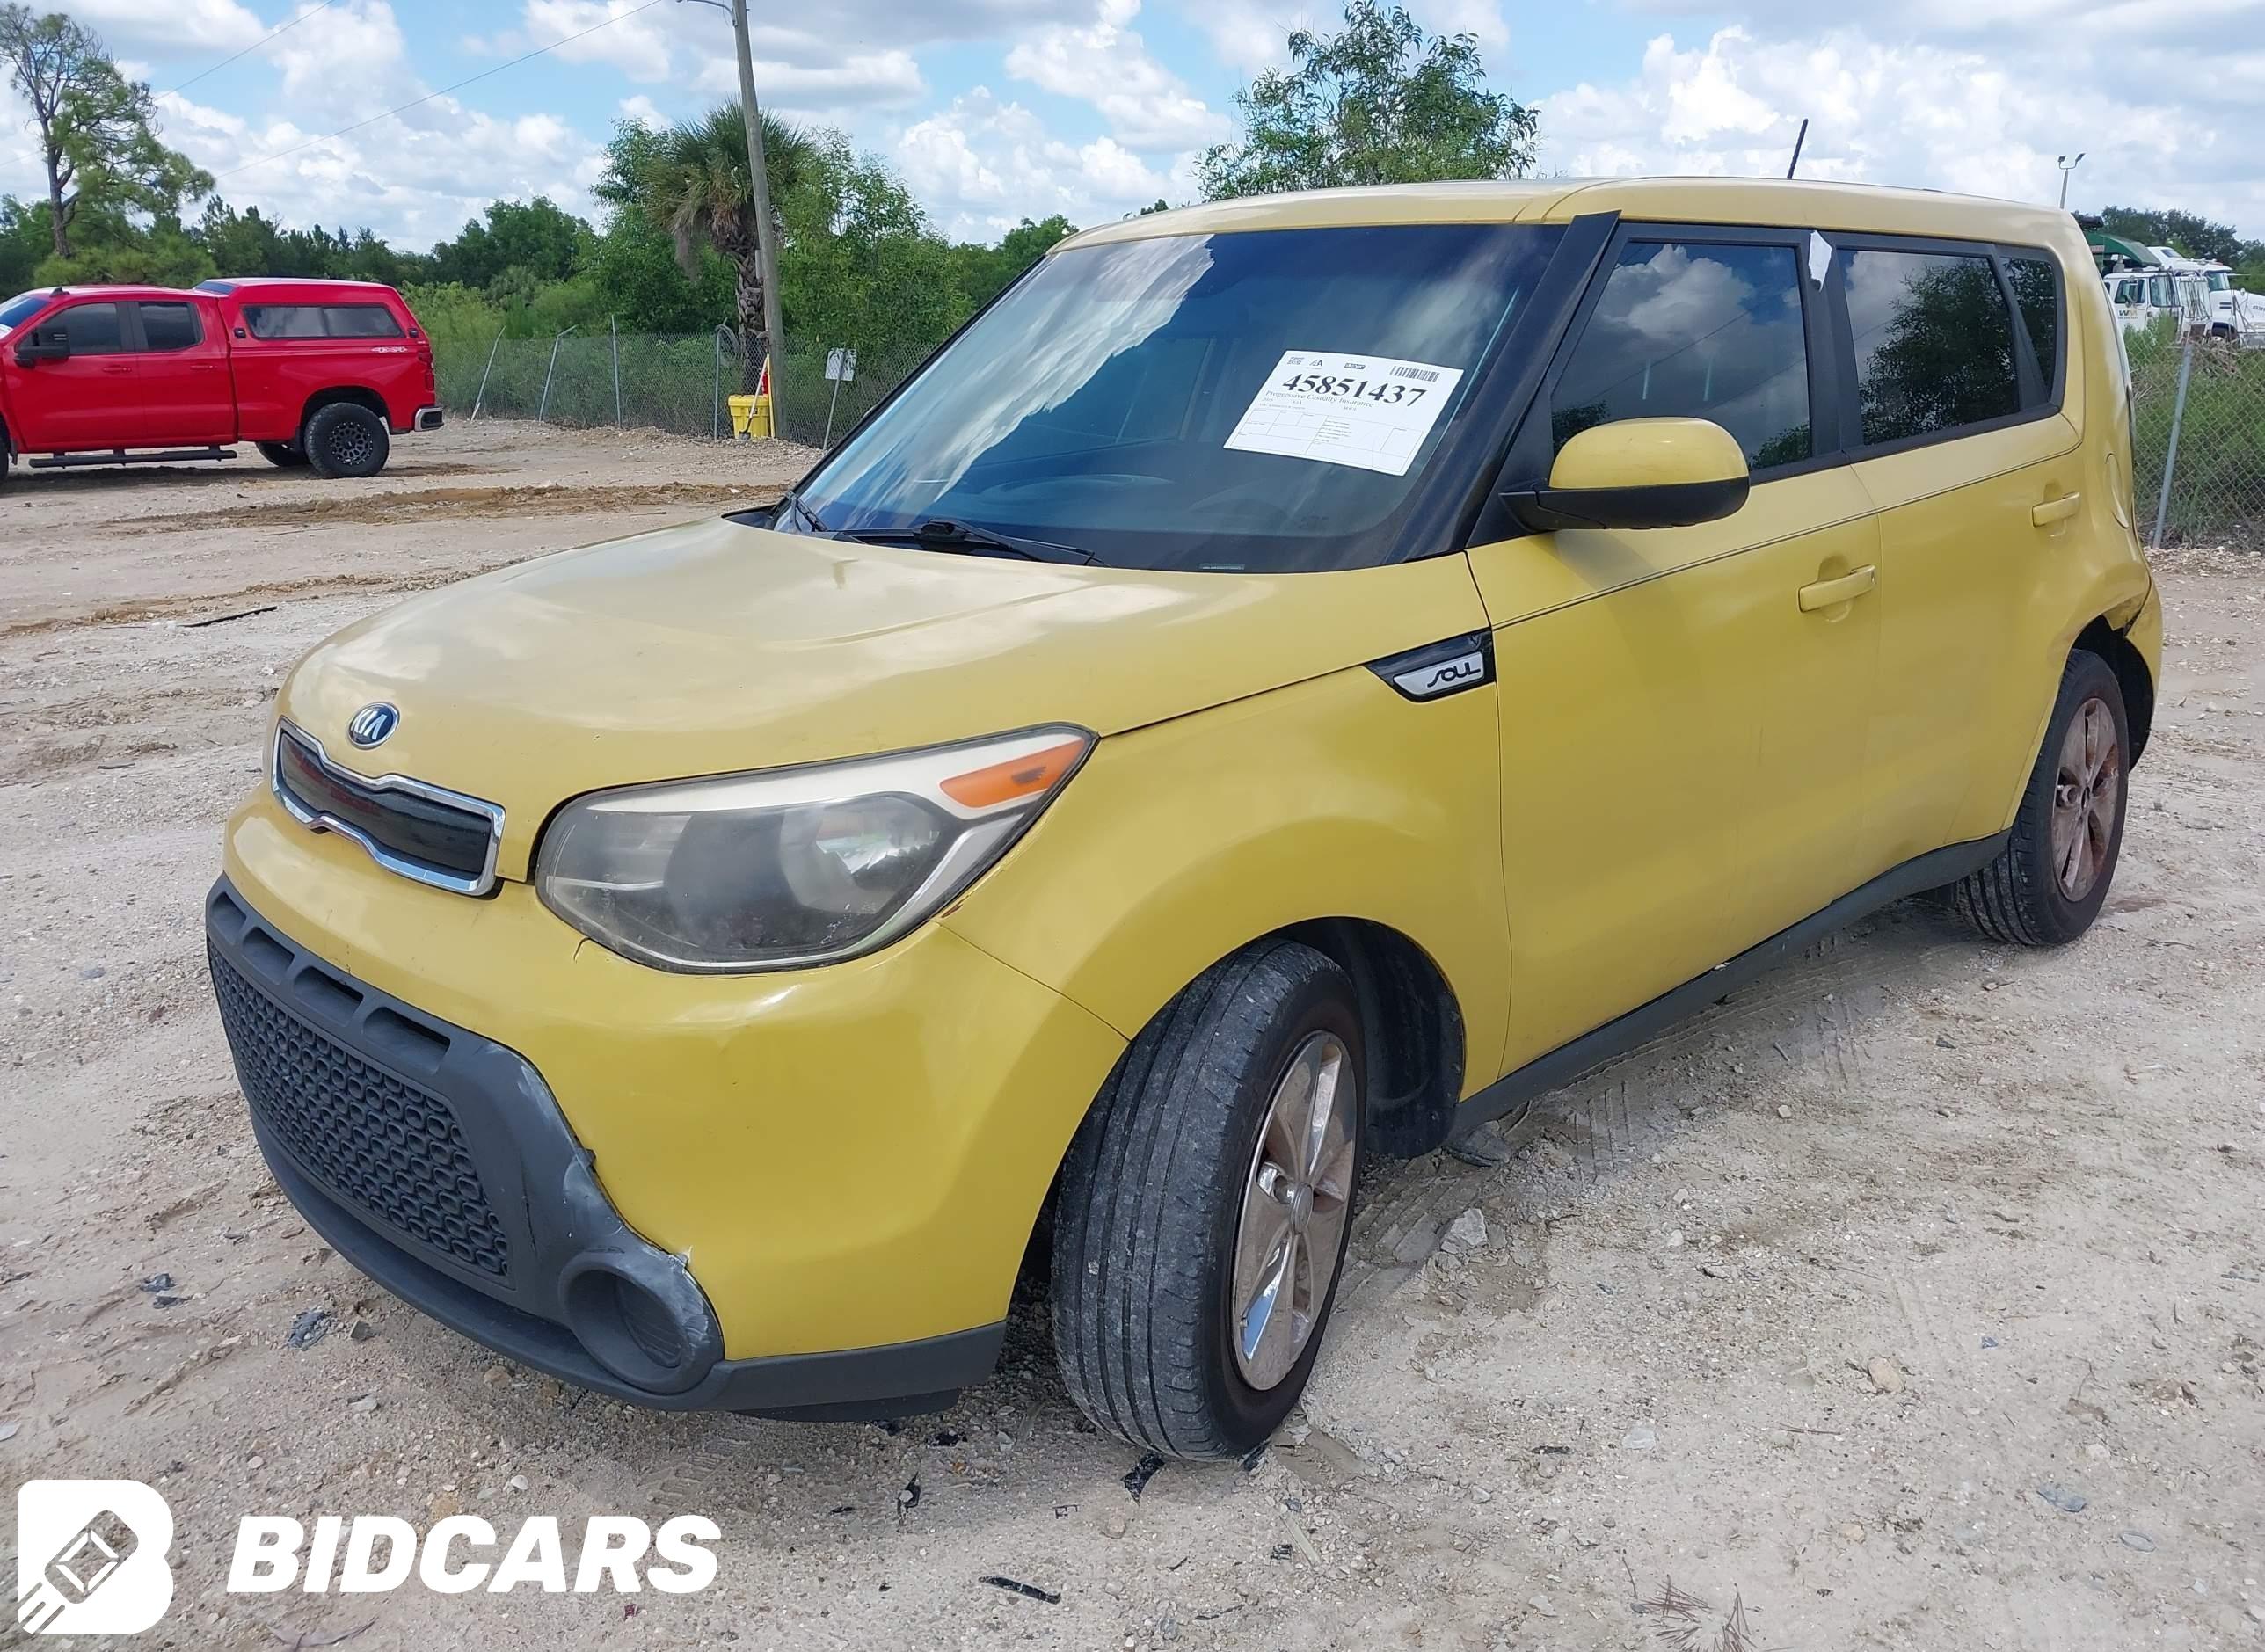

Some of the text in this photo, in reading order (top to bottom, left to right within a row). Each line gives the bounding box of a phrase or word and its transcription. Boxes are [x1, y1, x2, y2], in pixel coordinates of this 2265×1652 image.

[1265, 389, 1307, 400] Progressive
[1307, 394, 1337, 404] Casualty
[1339, 397, 1374, 408] Insurance
[1283, 373, 1428, 407] 45851437
[1426, 661, 1482, 688] SOUL
